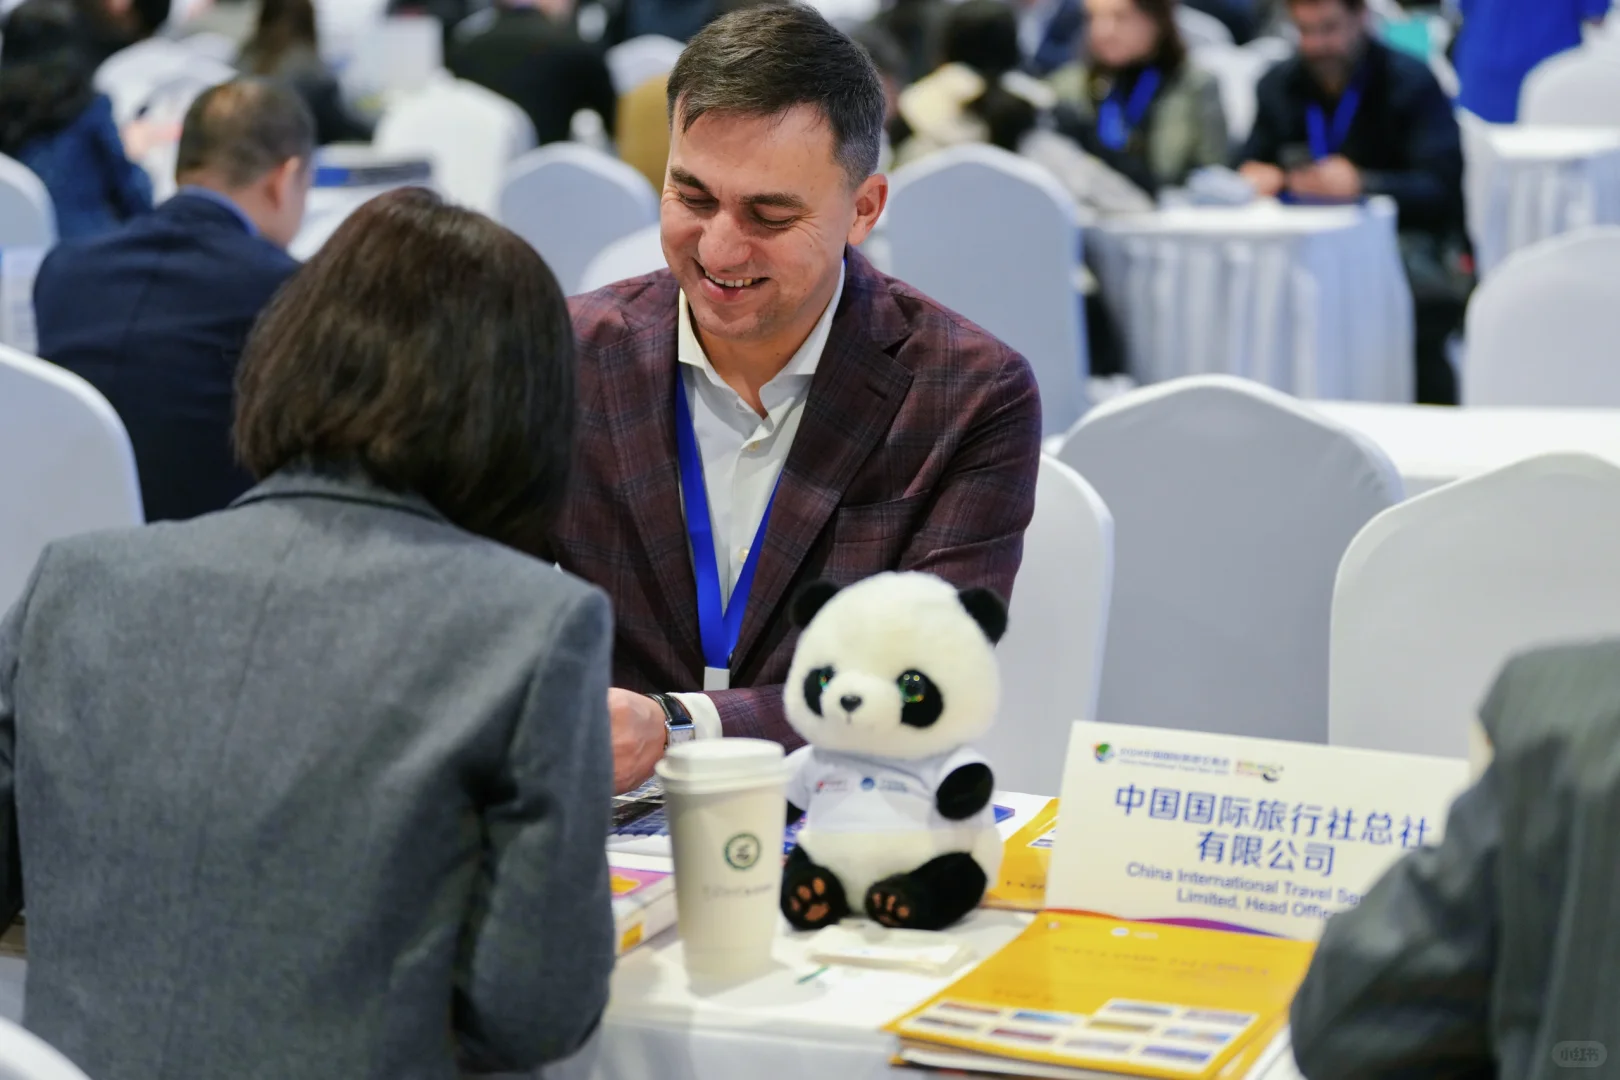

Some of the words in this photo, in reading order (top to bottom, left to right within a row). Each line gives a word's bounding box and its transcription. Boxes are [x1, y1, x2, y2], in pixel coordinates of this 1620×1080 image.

[1115, 783, 1431, 850] 中国国际旅行社总社
[1197, 830, 1336, 877] 有限公司
[1126, 861, 1173, 881] China
[1178, 868, 1279, 894] International
[1285, 880, 1333, 900] Travel
[1176, 888, 1239, 909] Limited,
[1246, 896, 1288, 916] Head
